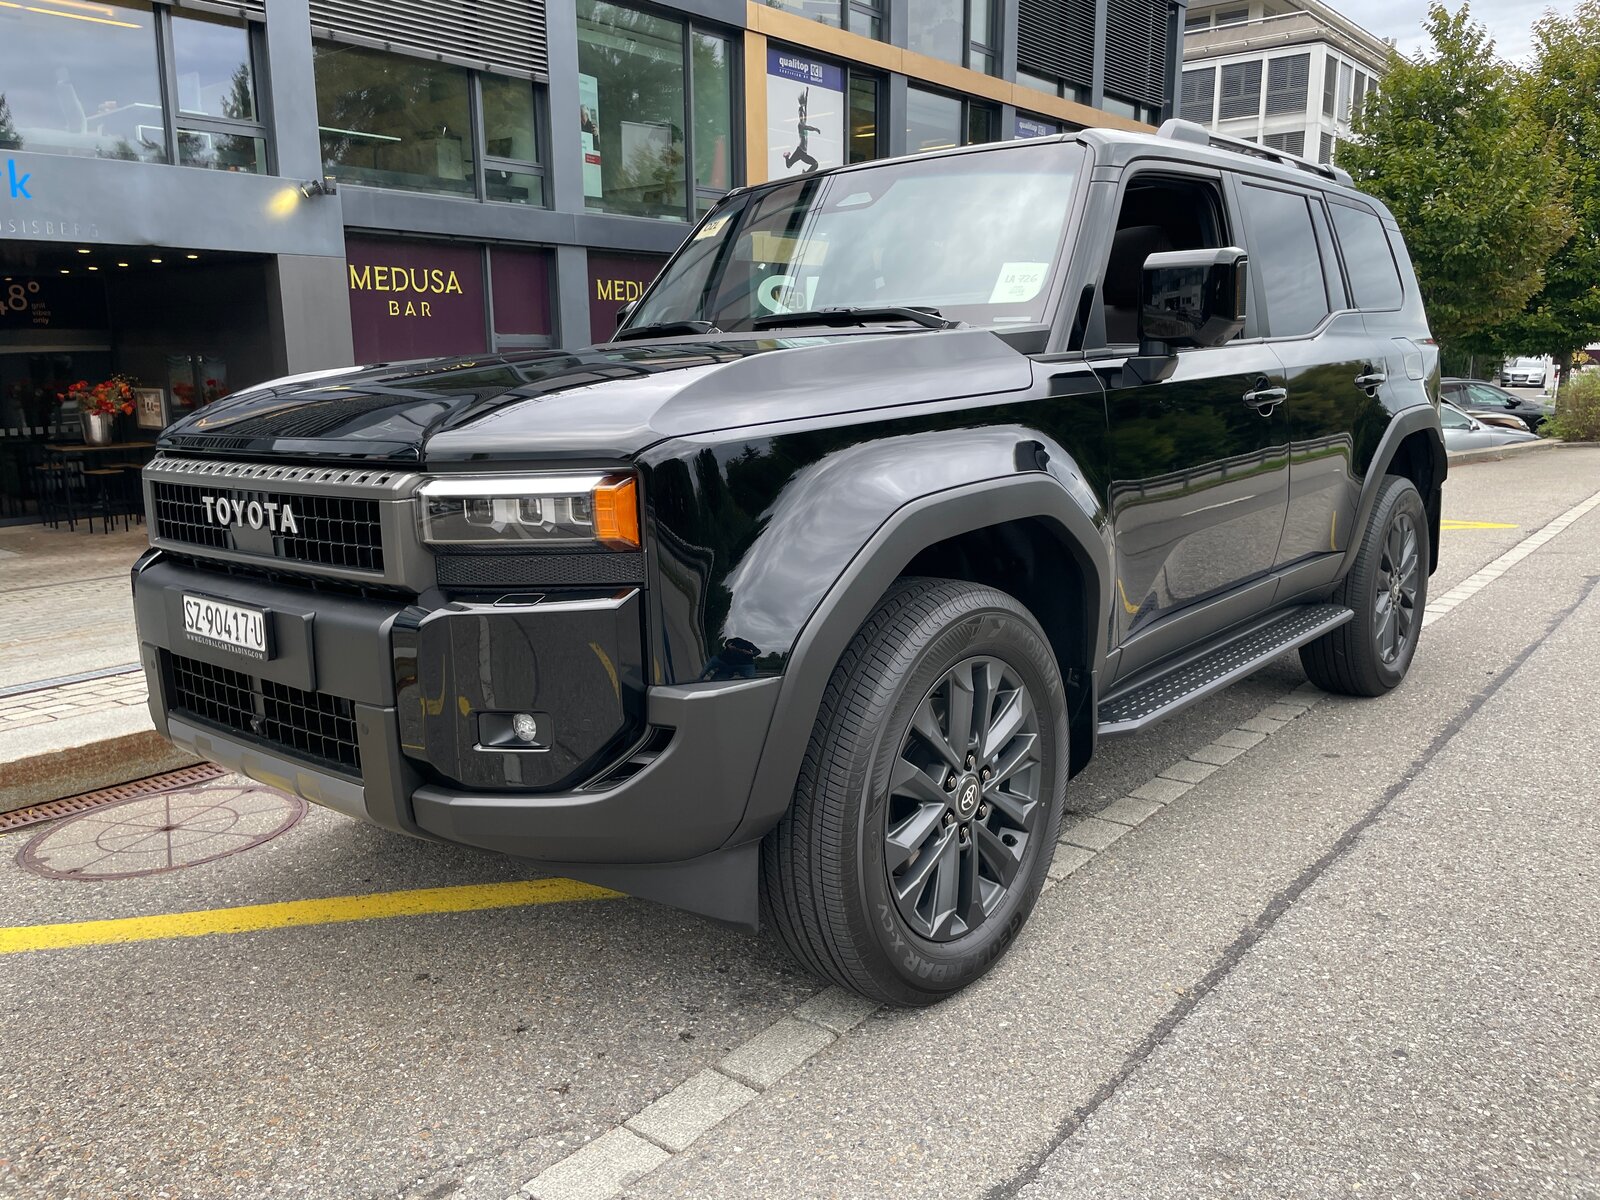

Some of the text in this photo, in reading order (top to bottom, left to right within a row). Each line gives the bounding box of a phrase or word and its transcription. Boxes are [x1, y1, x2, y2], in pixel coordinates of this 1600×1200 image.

[779, 57, 809, 73] qualitop
[0, 158, 32, 199] k
[349, 264, 463, 294] MEDUSA
[388, 300, 432, 317] BAR
[202, 496, 298, 534] TOYOTA
